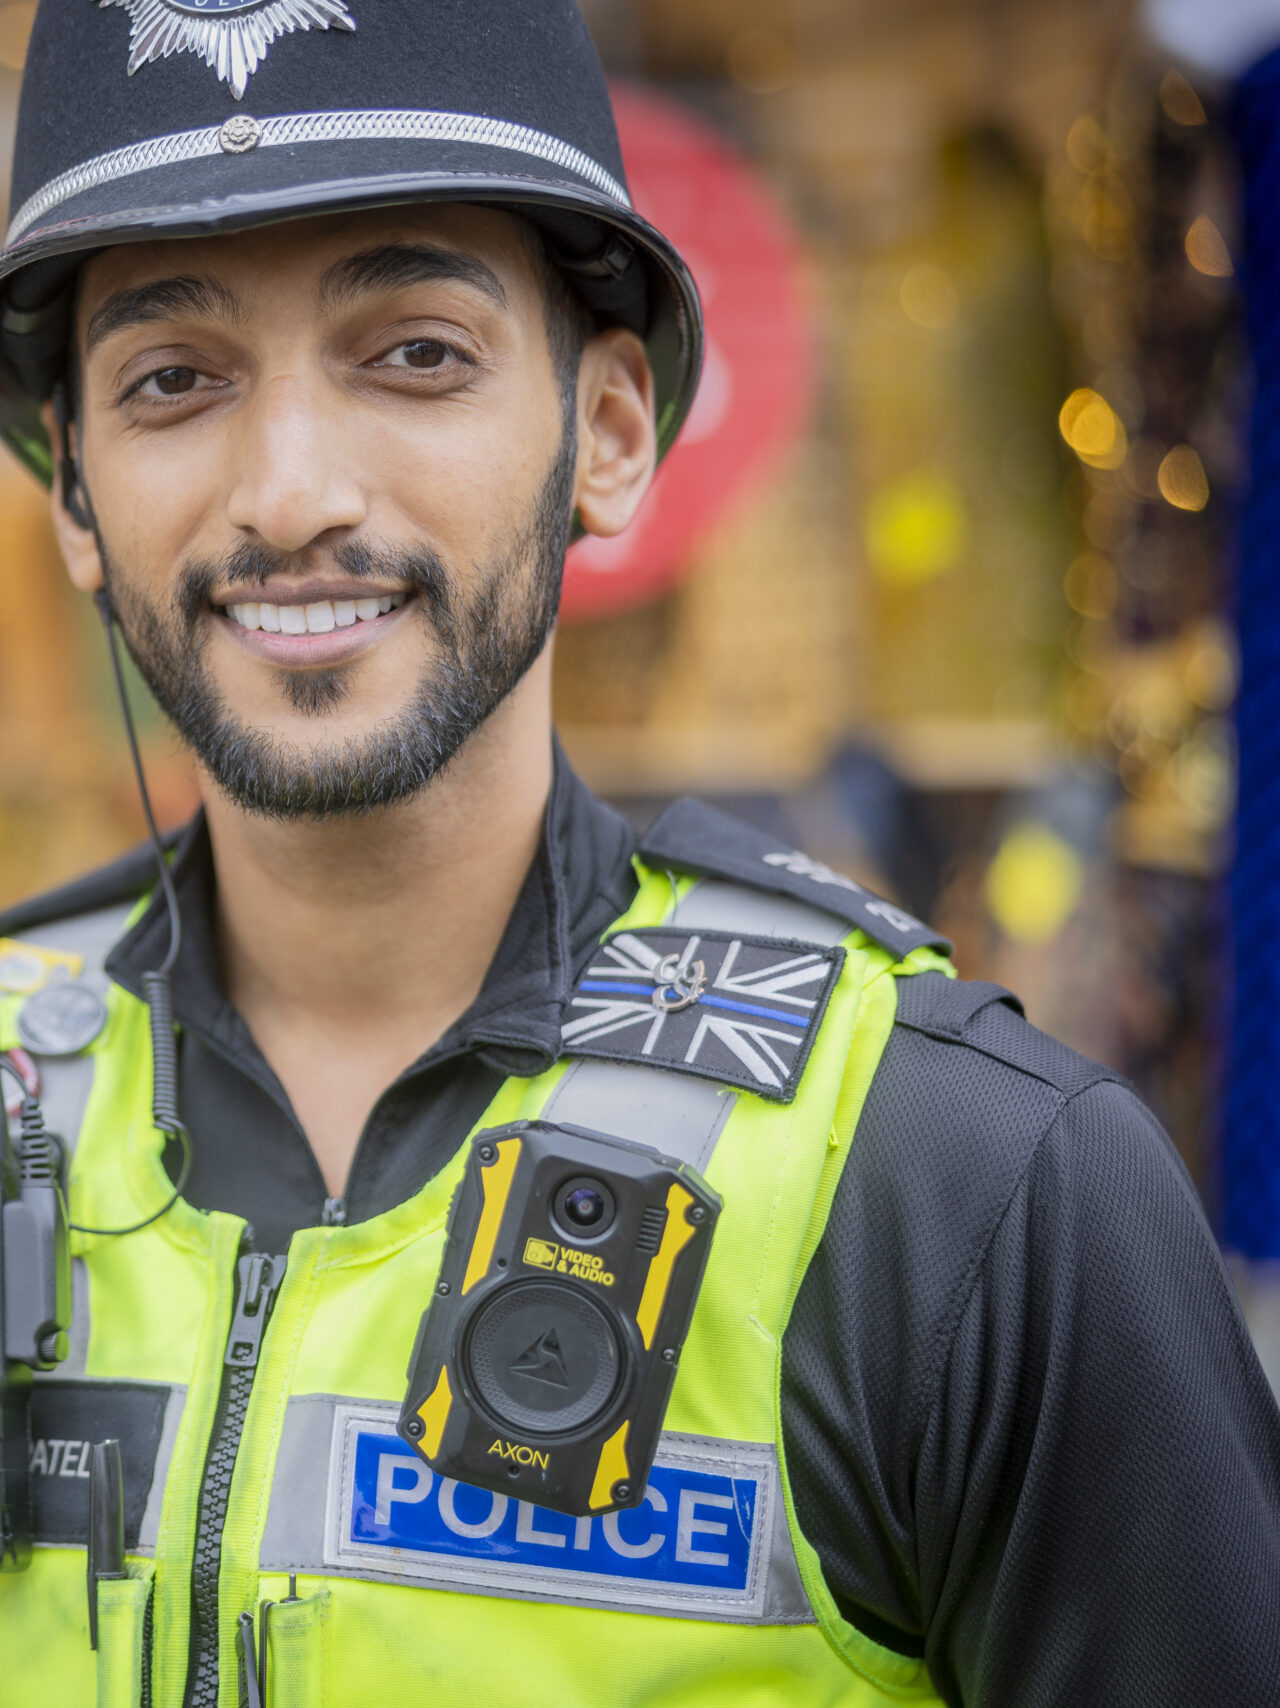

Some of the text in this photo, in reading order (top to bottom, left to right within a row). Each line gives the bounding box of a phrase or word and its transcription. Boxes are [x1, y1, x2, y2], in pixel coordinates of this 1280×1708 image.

[561, 1247, 603, 1270] VIDEO
[556, 1260, 615, 1286] & AUDIO
[28, 1439, 90, 1478] ATEL
[488, 1439, 549, 1470] AXON
